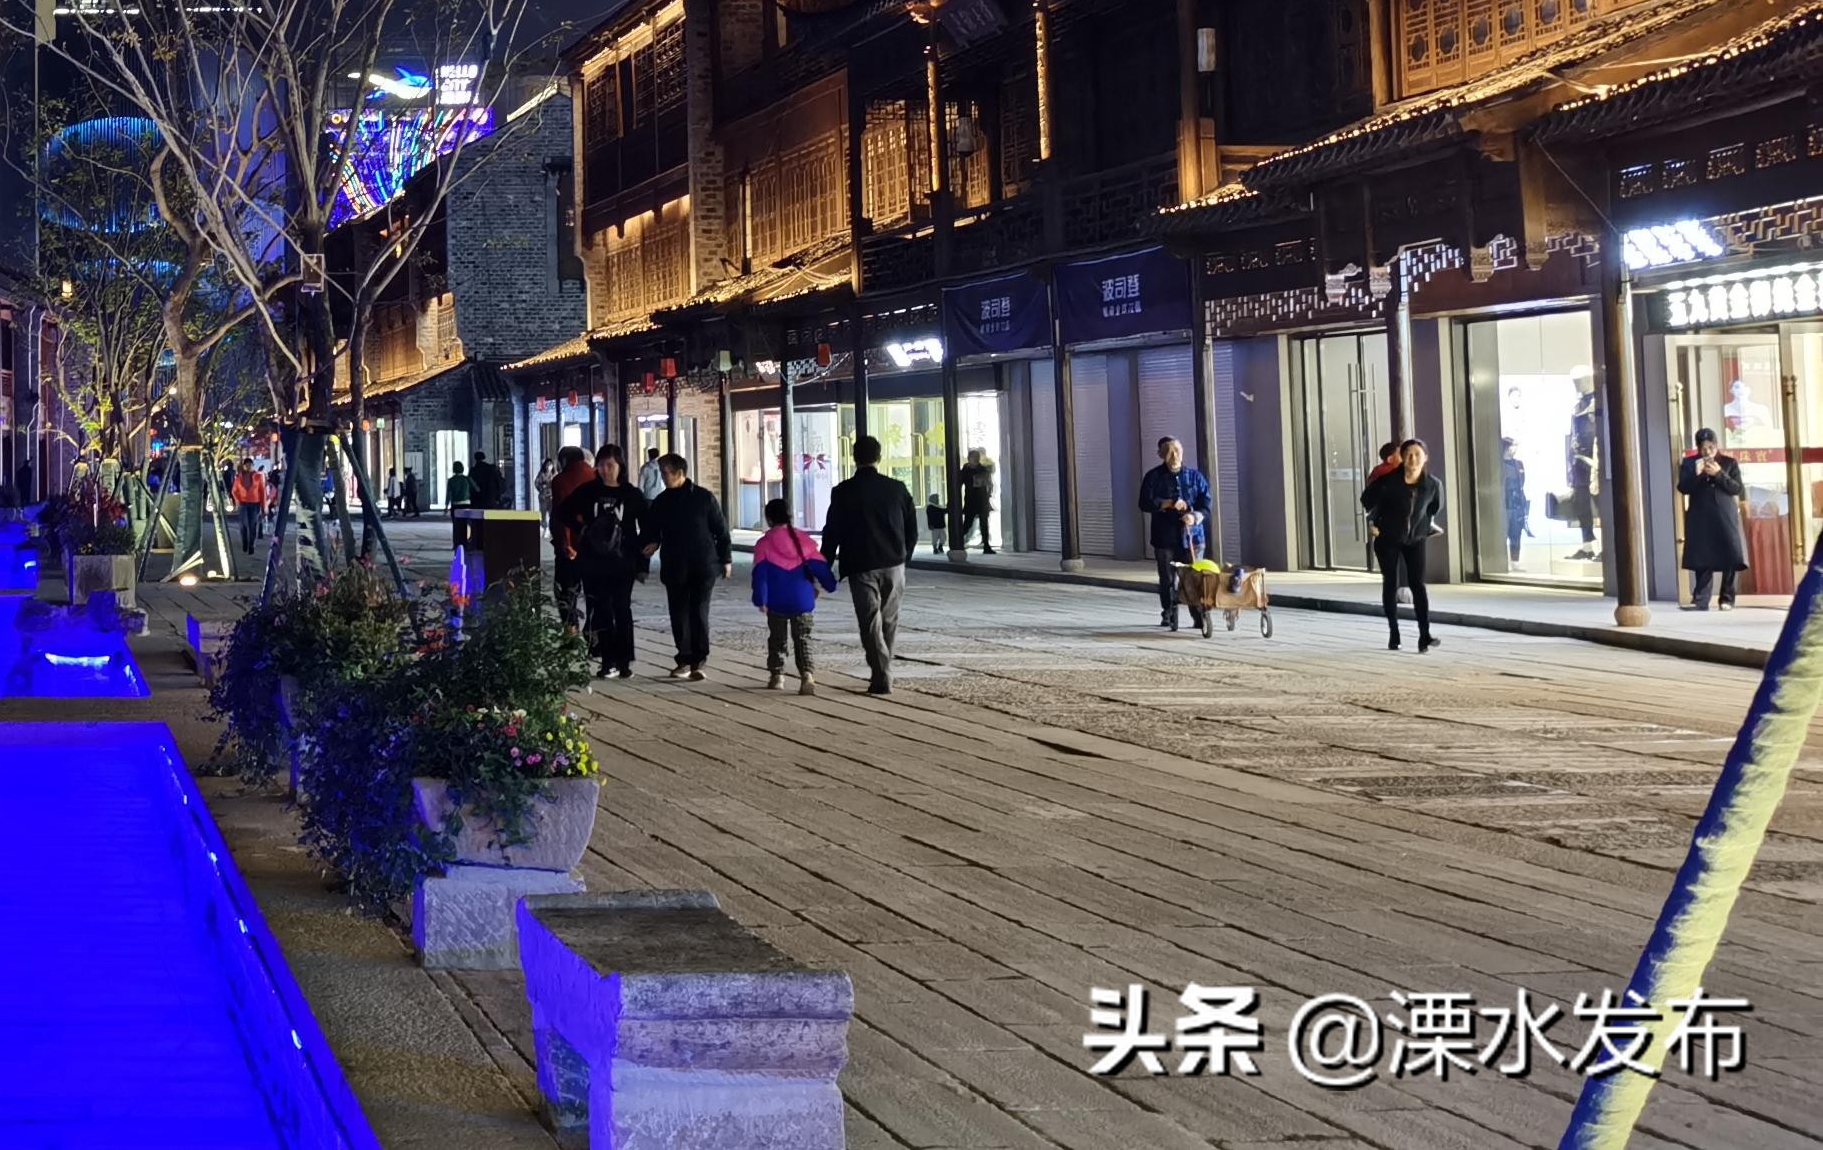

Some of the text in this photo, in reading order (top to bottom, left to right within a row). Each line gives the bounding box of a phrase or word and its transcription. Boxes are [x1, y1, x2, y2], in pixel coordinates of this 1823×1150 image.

[1102, 274, 1140, 302] 波司登
[980, 297, 1010, 320] 波司登
